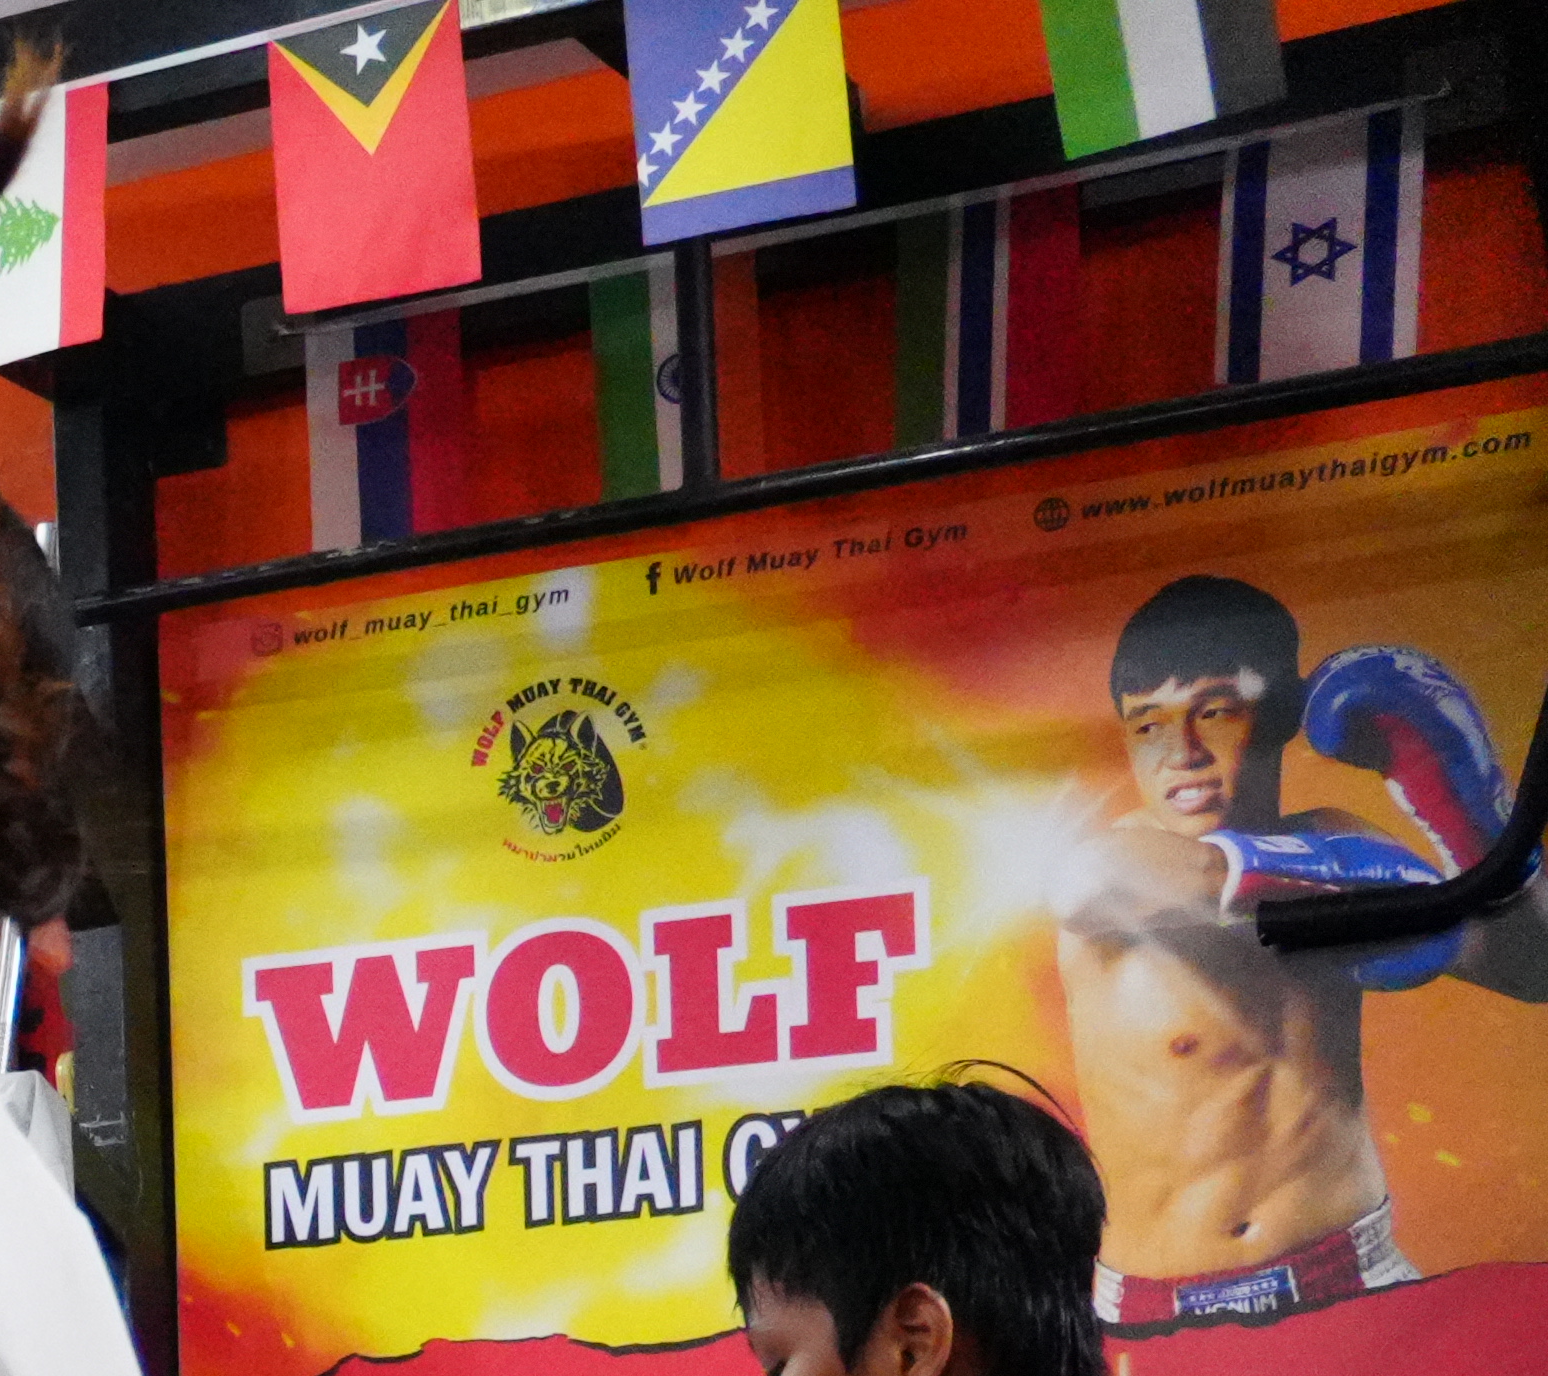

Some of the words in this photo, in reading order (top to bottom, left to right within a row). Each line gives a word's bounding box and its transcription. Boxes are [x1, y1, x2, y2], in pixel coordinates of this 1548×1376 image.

[1082, 428, 1532, 520] www.wolfmuaythaigym.com
[673, 555, 737, 587] Wolf
[747, 544, 818, 579] Muay
[832, 534, 893, 560] Thai
[904, 520, 970, 555] Gym
[293, 586, 570, 648] wolf_muay_thai_gym
[471, 710, 505, 768] WOLF
[506, 678, 561, 714] MUAY
[568, 677, 618, 707] THAI
[614, 701, 646, 744] GYM
[249, 884, 923, 1118] WOLF
[264, 1139, 501, 1250] MUAY
[510, 1119, 705, 1229] THAI
